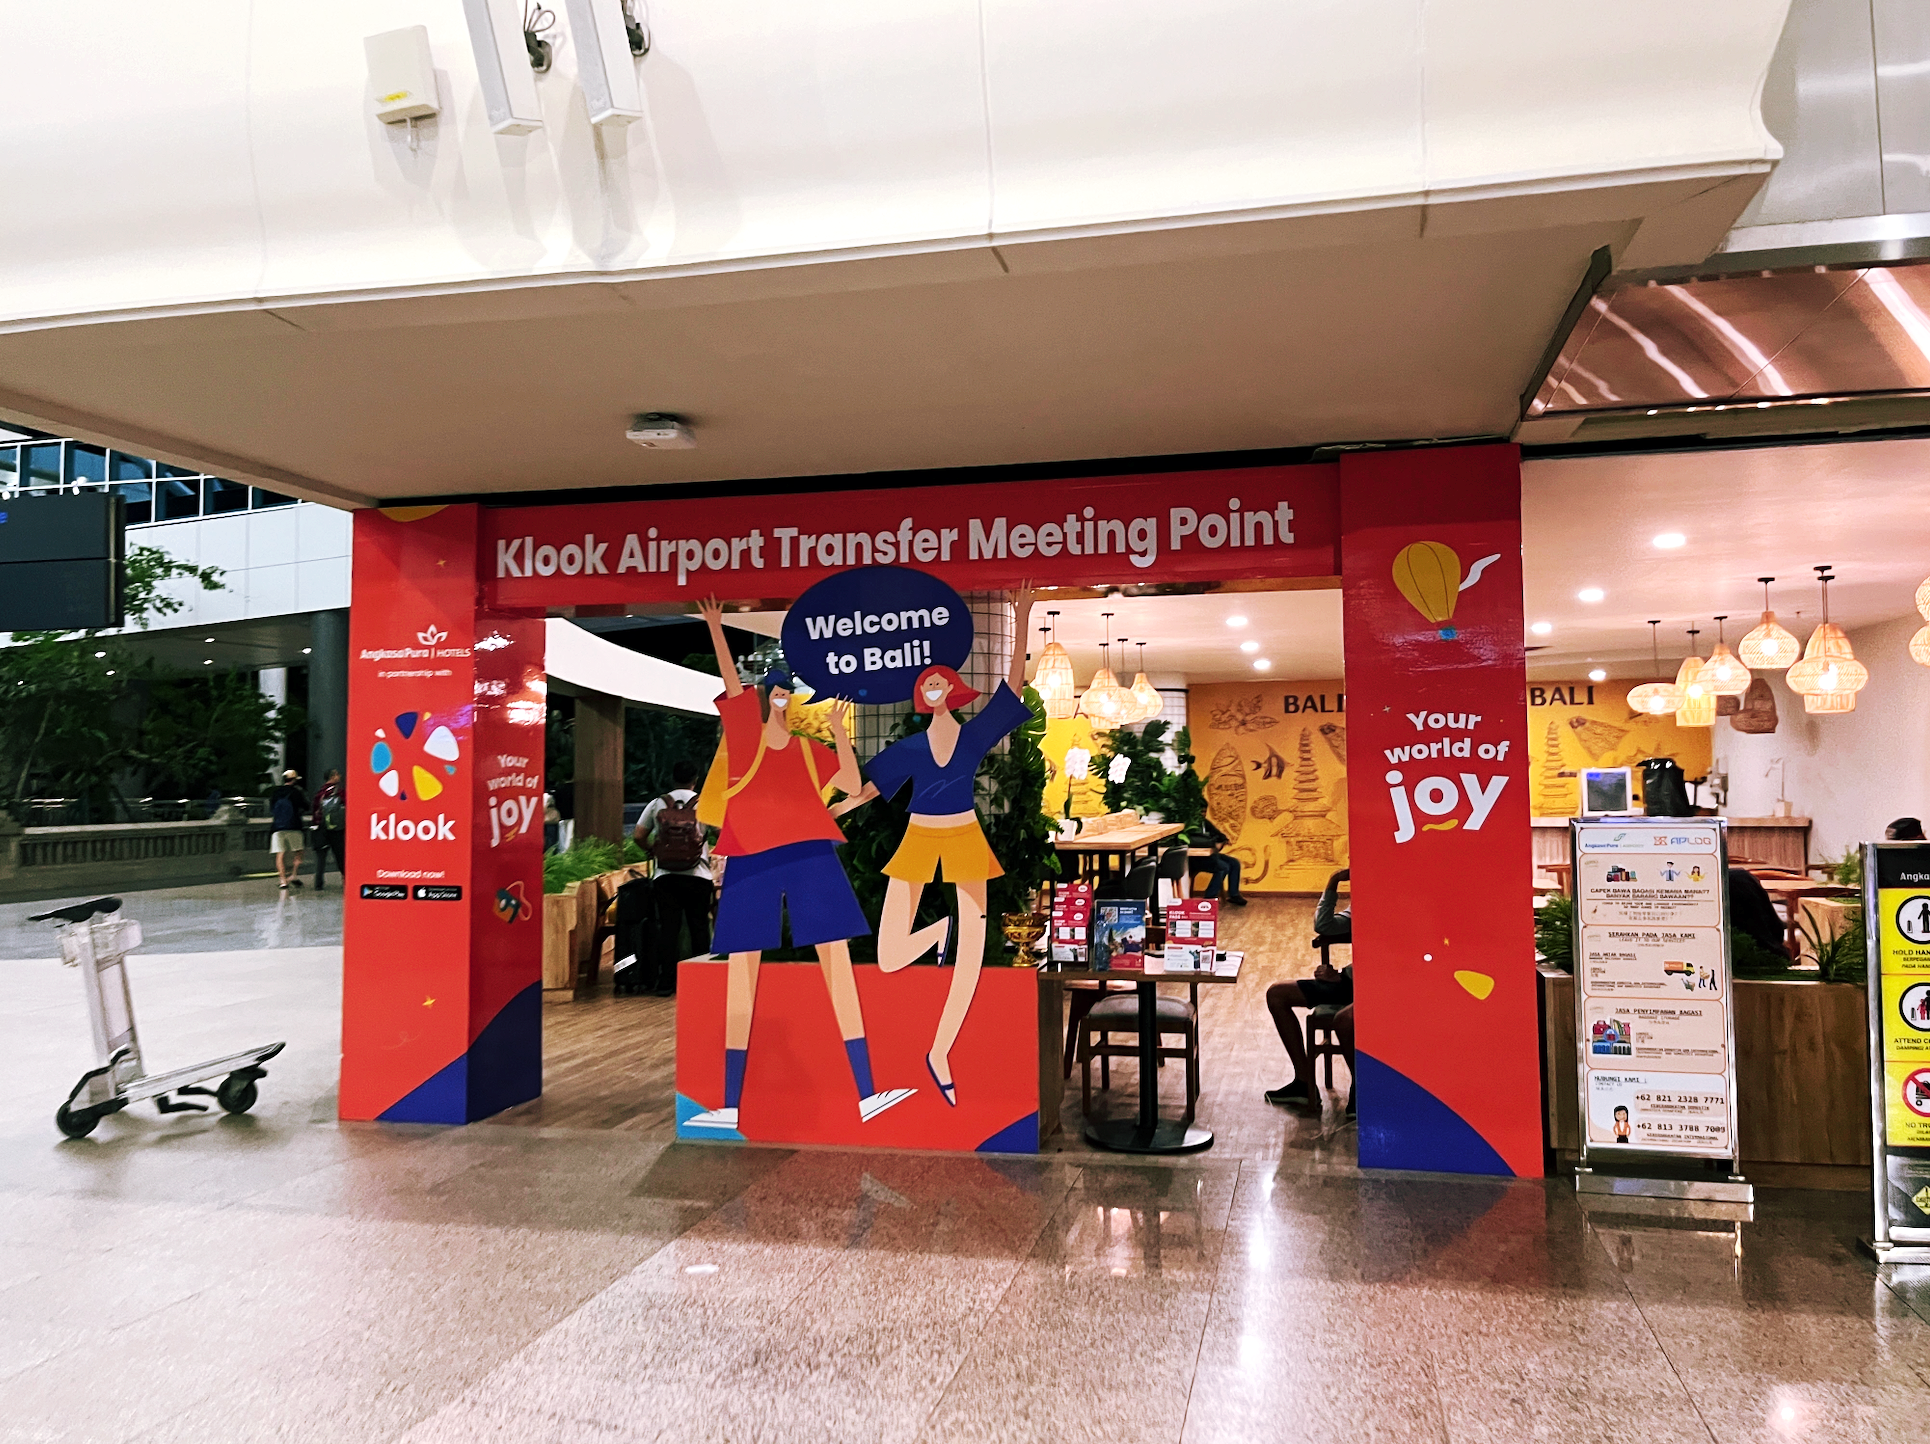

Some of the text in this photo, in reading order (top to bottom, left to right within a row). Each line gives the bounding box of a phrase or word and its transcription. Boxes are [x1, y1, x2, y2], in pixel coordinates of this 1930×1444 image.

[497, 497, 1295, 586] Klook Airport Transfer Meeting Point
[805, 606, 950, 640] Welcome
[436, 648, 471, 658] HOTELS
[826, 639, 932, 675] to Bali!
[387, 669, 434, 678] partnership
[435, 669, 452, 677] with
[1284, 694, 1345, 714] BALI
[1530, 686, 1595, 706] BALI
[1406, 710, 1482, 731] Your
[1384, 737, 1510, 764] world of
[497, 754, 530, 768] Your
[487, 773, 540, 791] world of
[1385, 769, 1510, 844] joy
[370, 813, 456, 840] klook
[488, 795, 539, 848] joy
[376, 869, 422, 879] Download
[1656, 1094, 1671, 1102] 821
[1704, 1096, 1725, 1105] 7771
